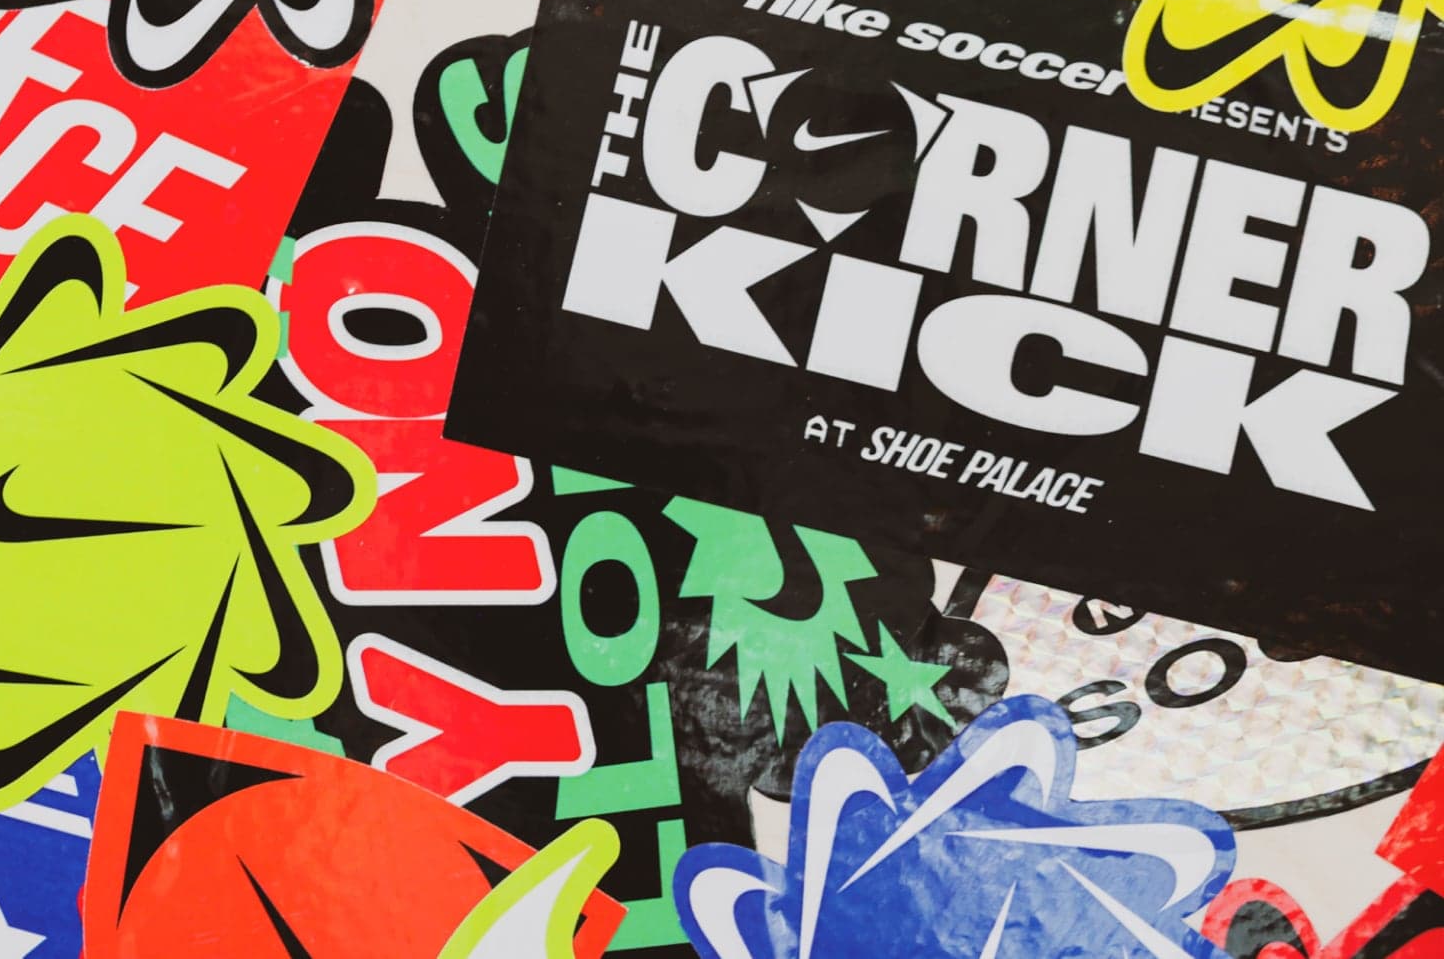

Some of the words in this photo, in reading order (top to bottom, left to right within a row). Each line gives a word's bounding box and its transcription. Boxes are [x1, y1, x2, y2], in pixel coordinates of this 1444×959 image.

[591, 20, 661, 187] THE
[896, 22, 1126, 96] soccer
[1174, 96, 1349, 153] ESENTS
[562, 193, 1399, 512] KICK
[804, 415, 855, 447] AT
[860, 426, 964, 479] SHOE
[958, 449, 1105, 514] PALACE
